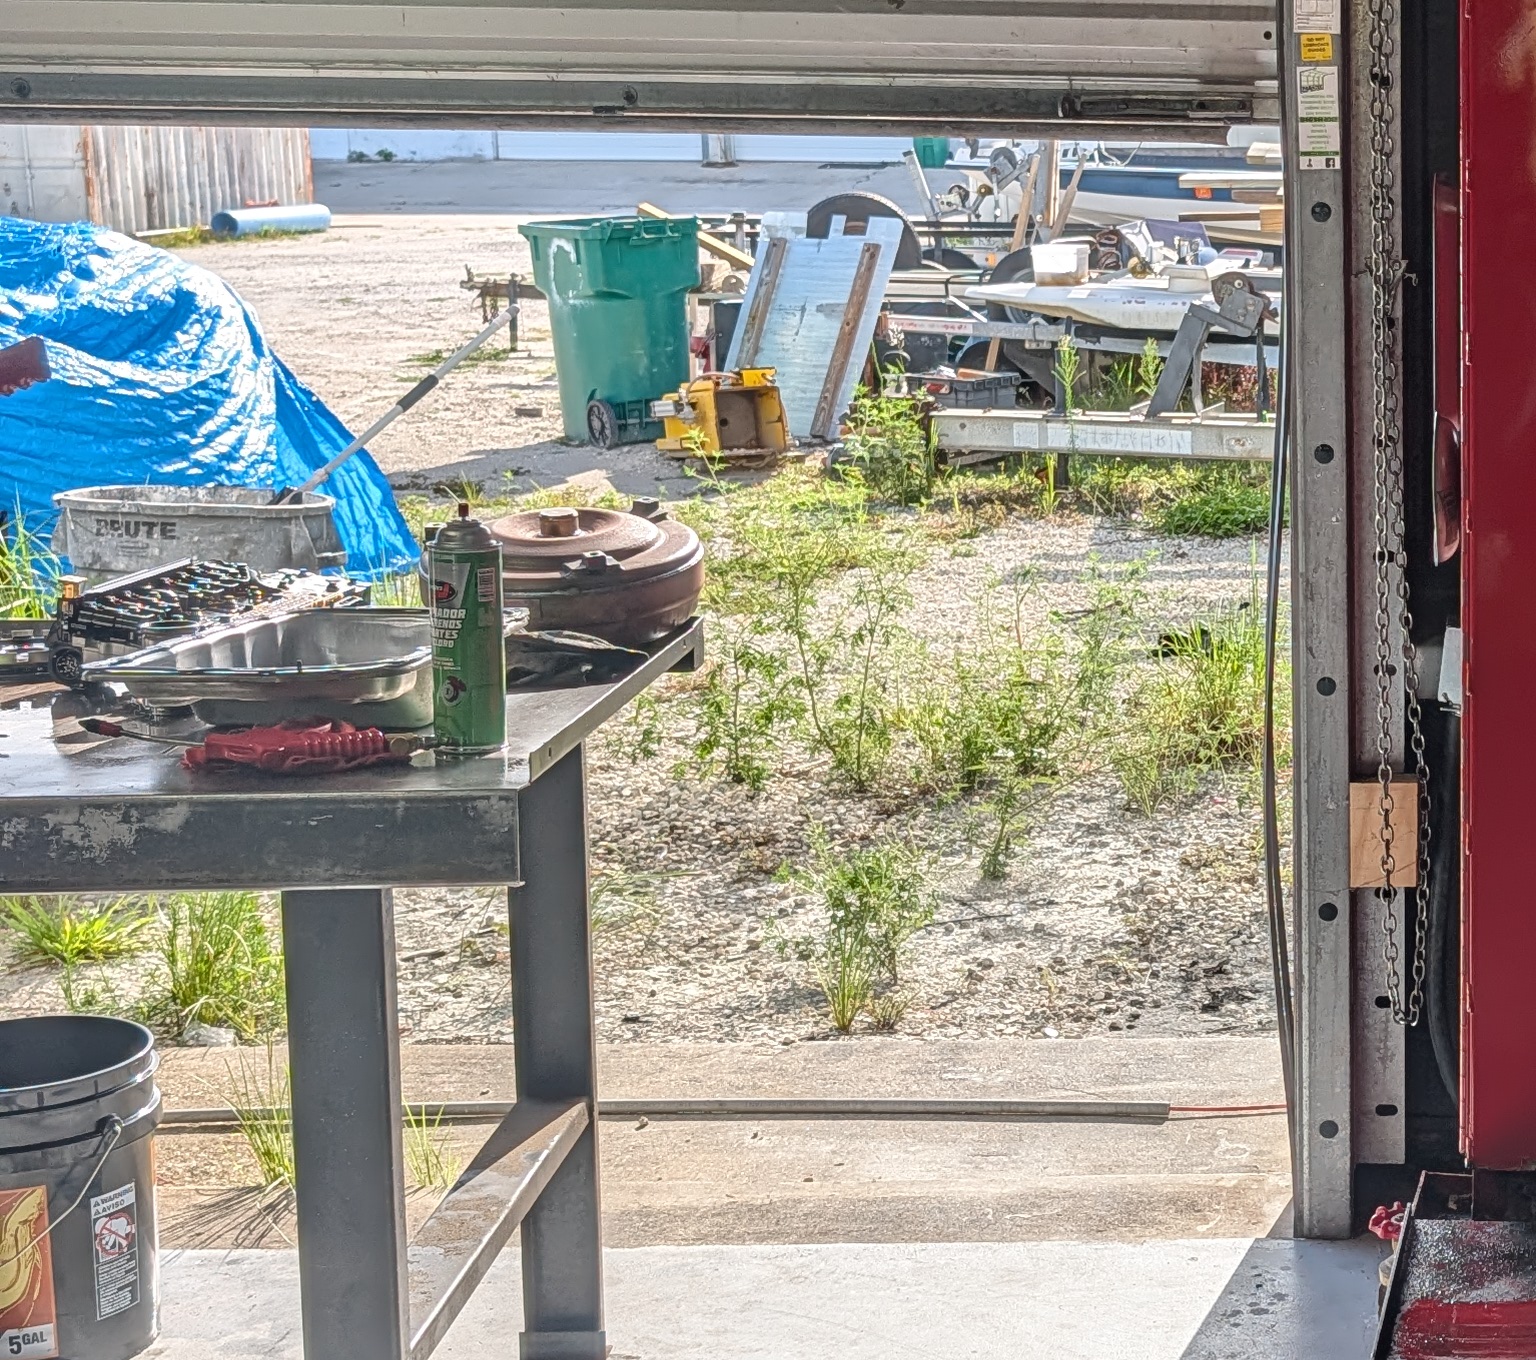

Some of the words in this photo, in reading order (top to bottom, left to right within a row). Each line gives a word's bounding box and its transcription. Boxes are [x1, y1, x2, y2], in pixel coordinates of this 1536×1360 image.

[95, 518, 177, 540] BRUTE
[100, 1186, 134, 1204] WARNING
[102, 1199, 125, 1213] AVISO
[8, 1335, 22, 1354] 5
[22, 1331, 47, 1345] GAL
